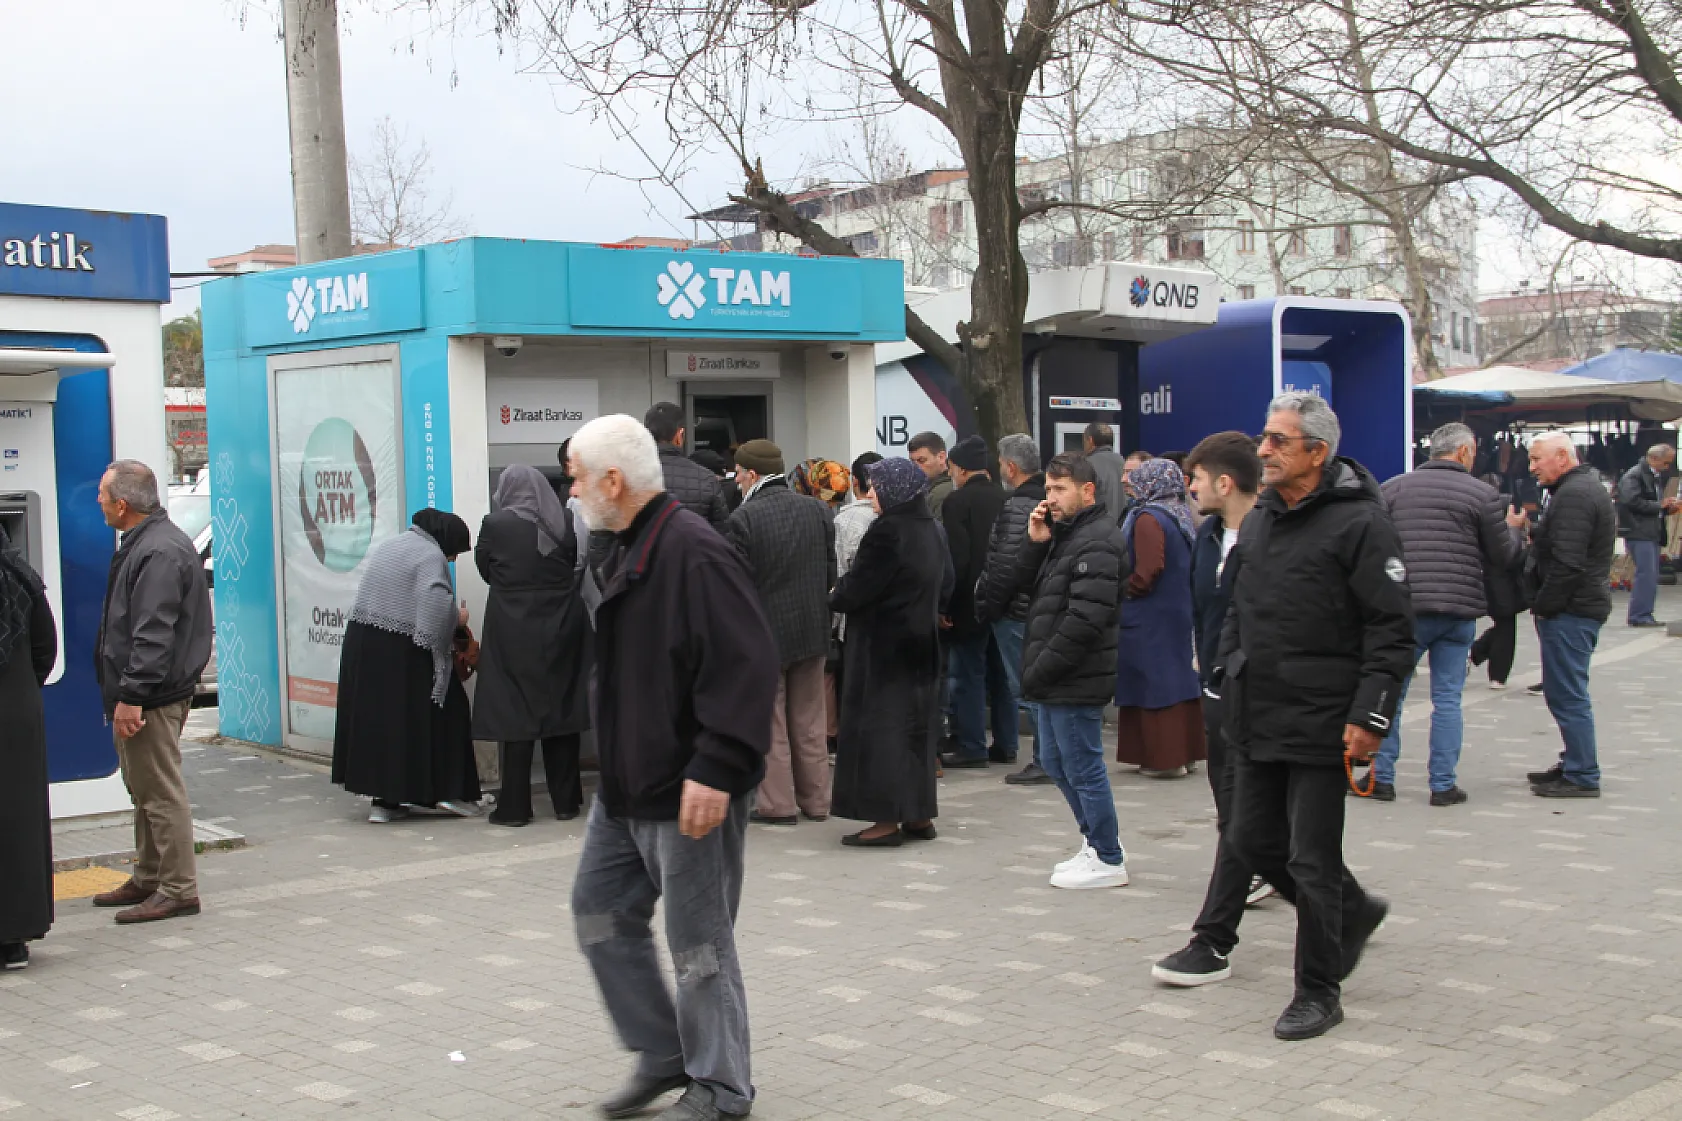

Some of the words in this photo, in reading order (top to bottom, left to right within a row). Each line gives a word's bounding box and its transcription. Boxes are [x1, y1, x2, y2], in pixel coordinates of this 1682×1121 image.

[0, 231, 95, 271] atik
[316, 272, 369, 314] TAM
[708, 267, 790, 306] TAM
[1153, 280, 1199, 309] QNB
[698, 357, 725, 370] Ziraat
[513, 408, 543, 422] Ziraat
[545, 408, 583, 422] Bankası
[315, 470, 353, 489] ORTAK
[315, 491, 356, 524] ATM
[313, 606, 344, 627] Ortak
